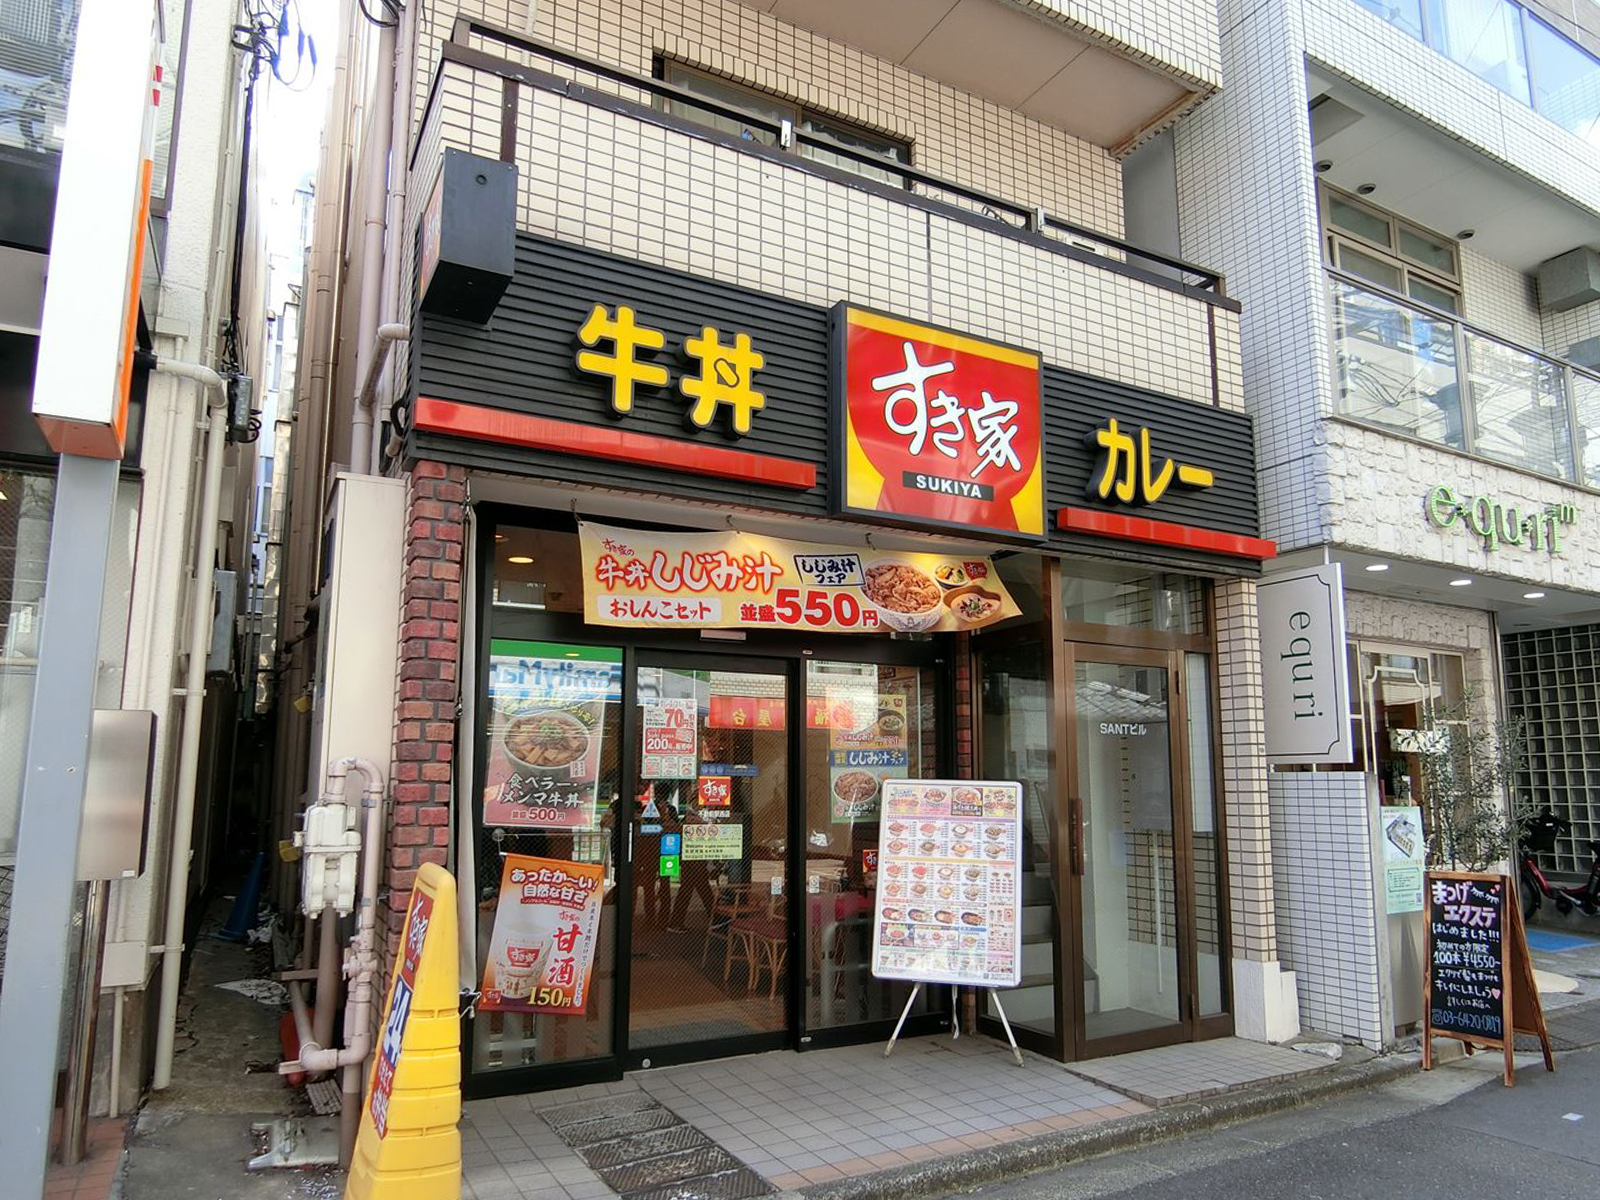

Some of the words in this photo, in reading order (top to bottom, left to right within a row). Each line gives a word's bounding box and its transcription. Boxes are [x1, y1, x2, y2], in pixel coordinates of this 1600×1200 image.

[576, 303, 766, 434] 牛丼
[871, 341, 1022, 478] すき家
[1097, 417, 1214, 503] カレー
[915, 475, 983, 499] SUKIYA
[596, 550, 784, 594] 牛丼しじみ汁
[801, 557, 857, 574] しじみ汁
[814, 573, 847, 585] フェア
[610, 598, 712, 620] おしんこセット
[1280, 611, 1323, 720] equri
[1100, 722, 1147, 736] SANTビル
[502, 791, 584, 808] メンマ牛丼
[702, 779, 728, 797] すき家
[523, 884, 588, 904] 自然な甘さ
[1431, 881, 1473, 905] まつげ
[1443, 904, 1497, 928] エクステ
[548, 923, 584, 986] 甘酒
[527, 986, 572, 1007] 150円
